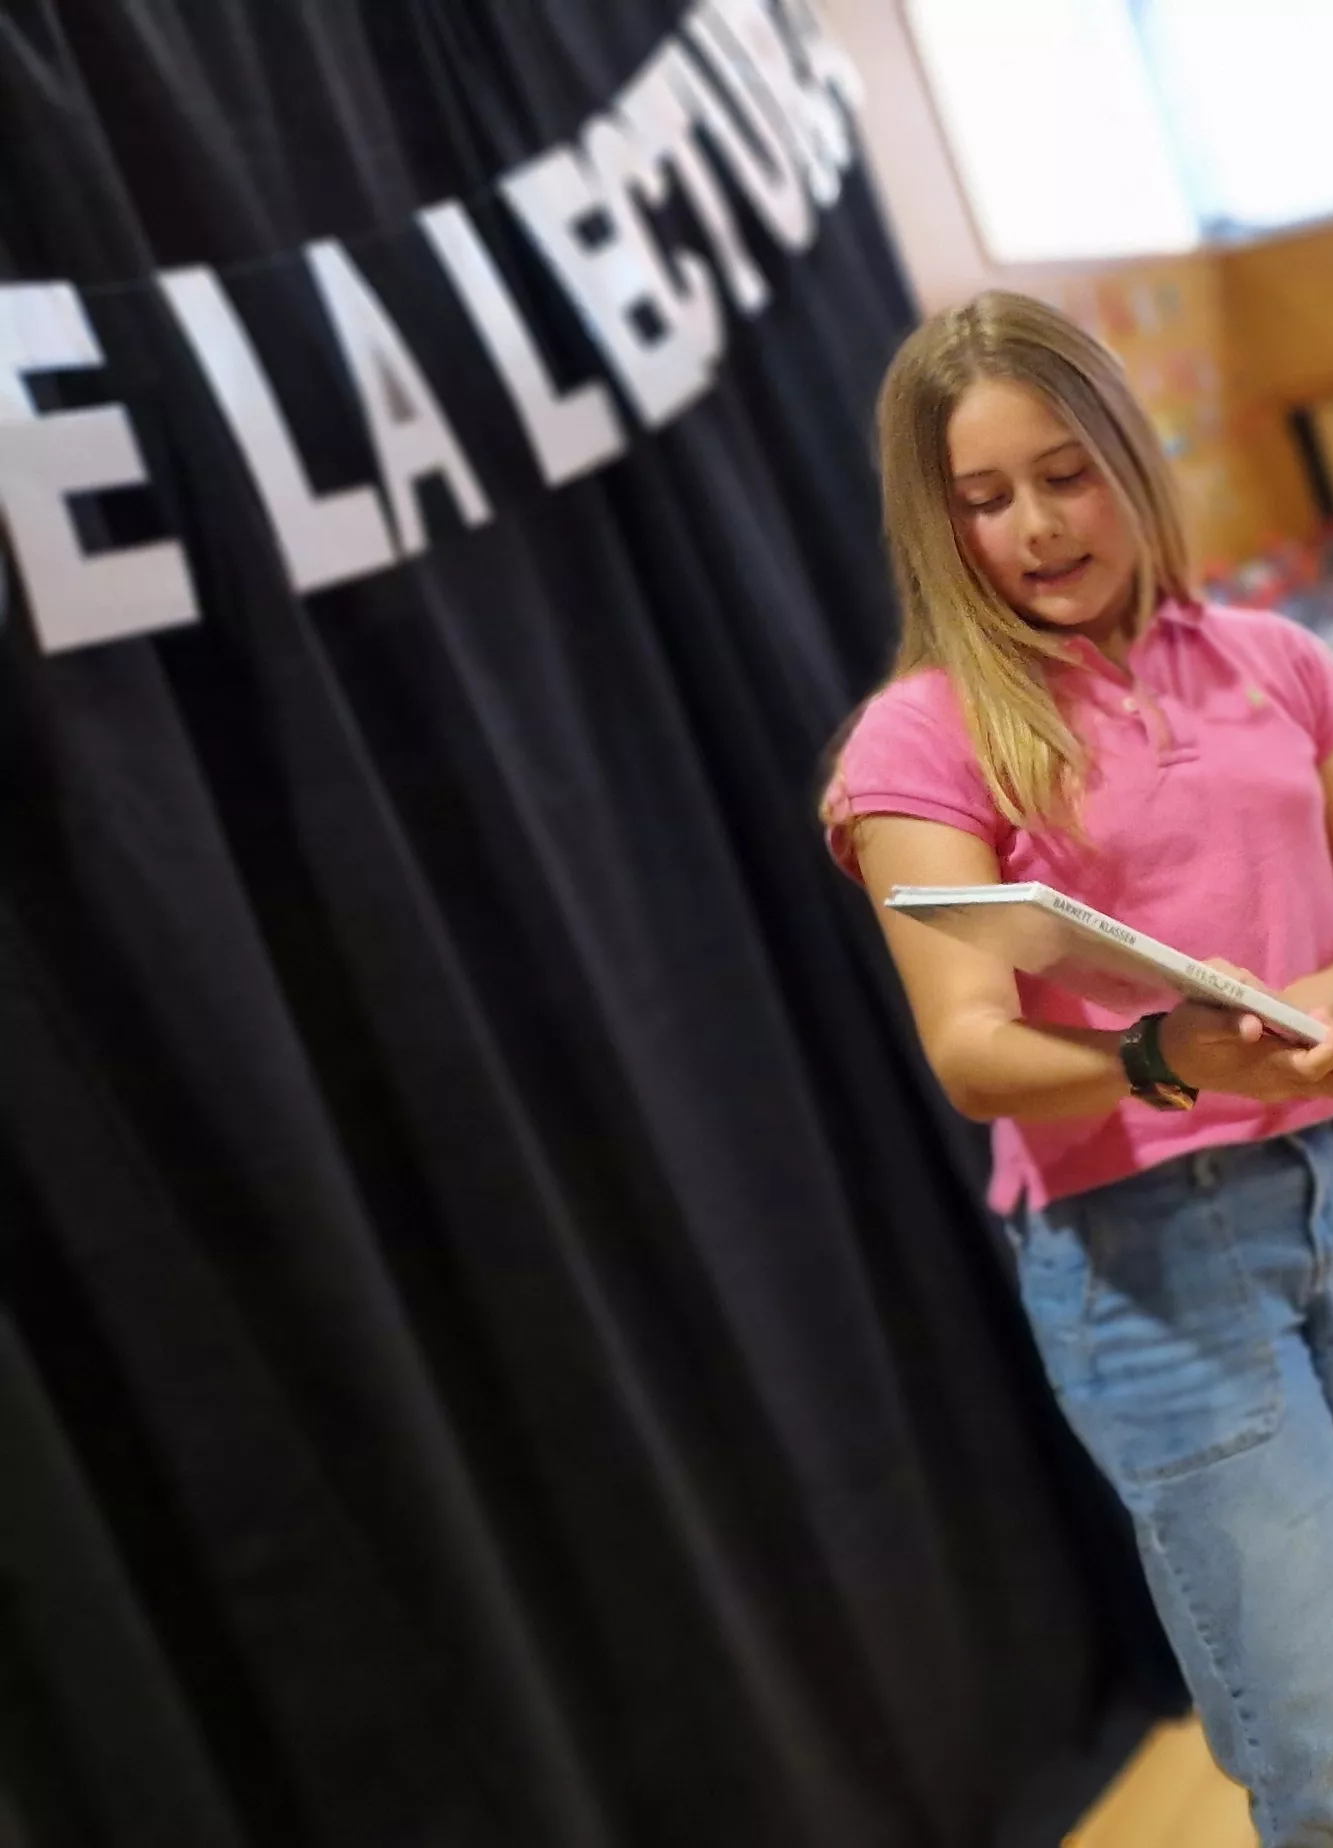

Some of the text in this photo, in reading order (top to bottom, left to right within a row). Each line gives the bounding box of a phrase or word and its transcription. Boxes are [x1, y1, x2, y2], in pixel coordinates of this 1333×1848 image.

[0, 0, 866, 655] E LA LECTU
